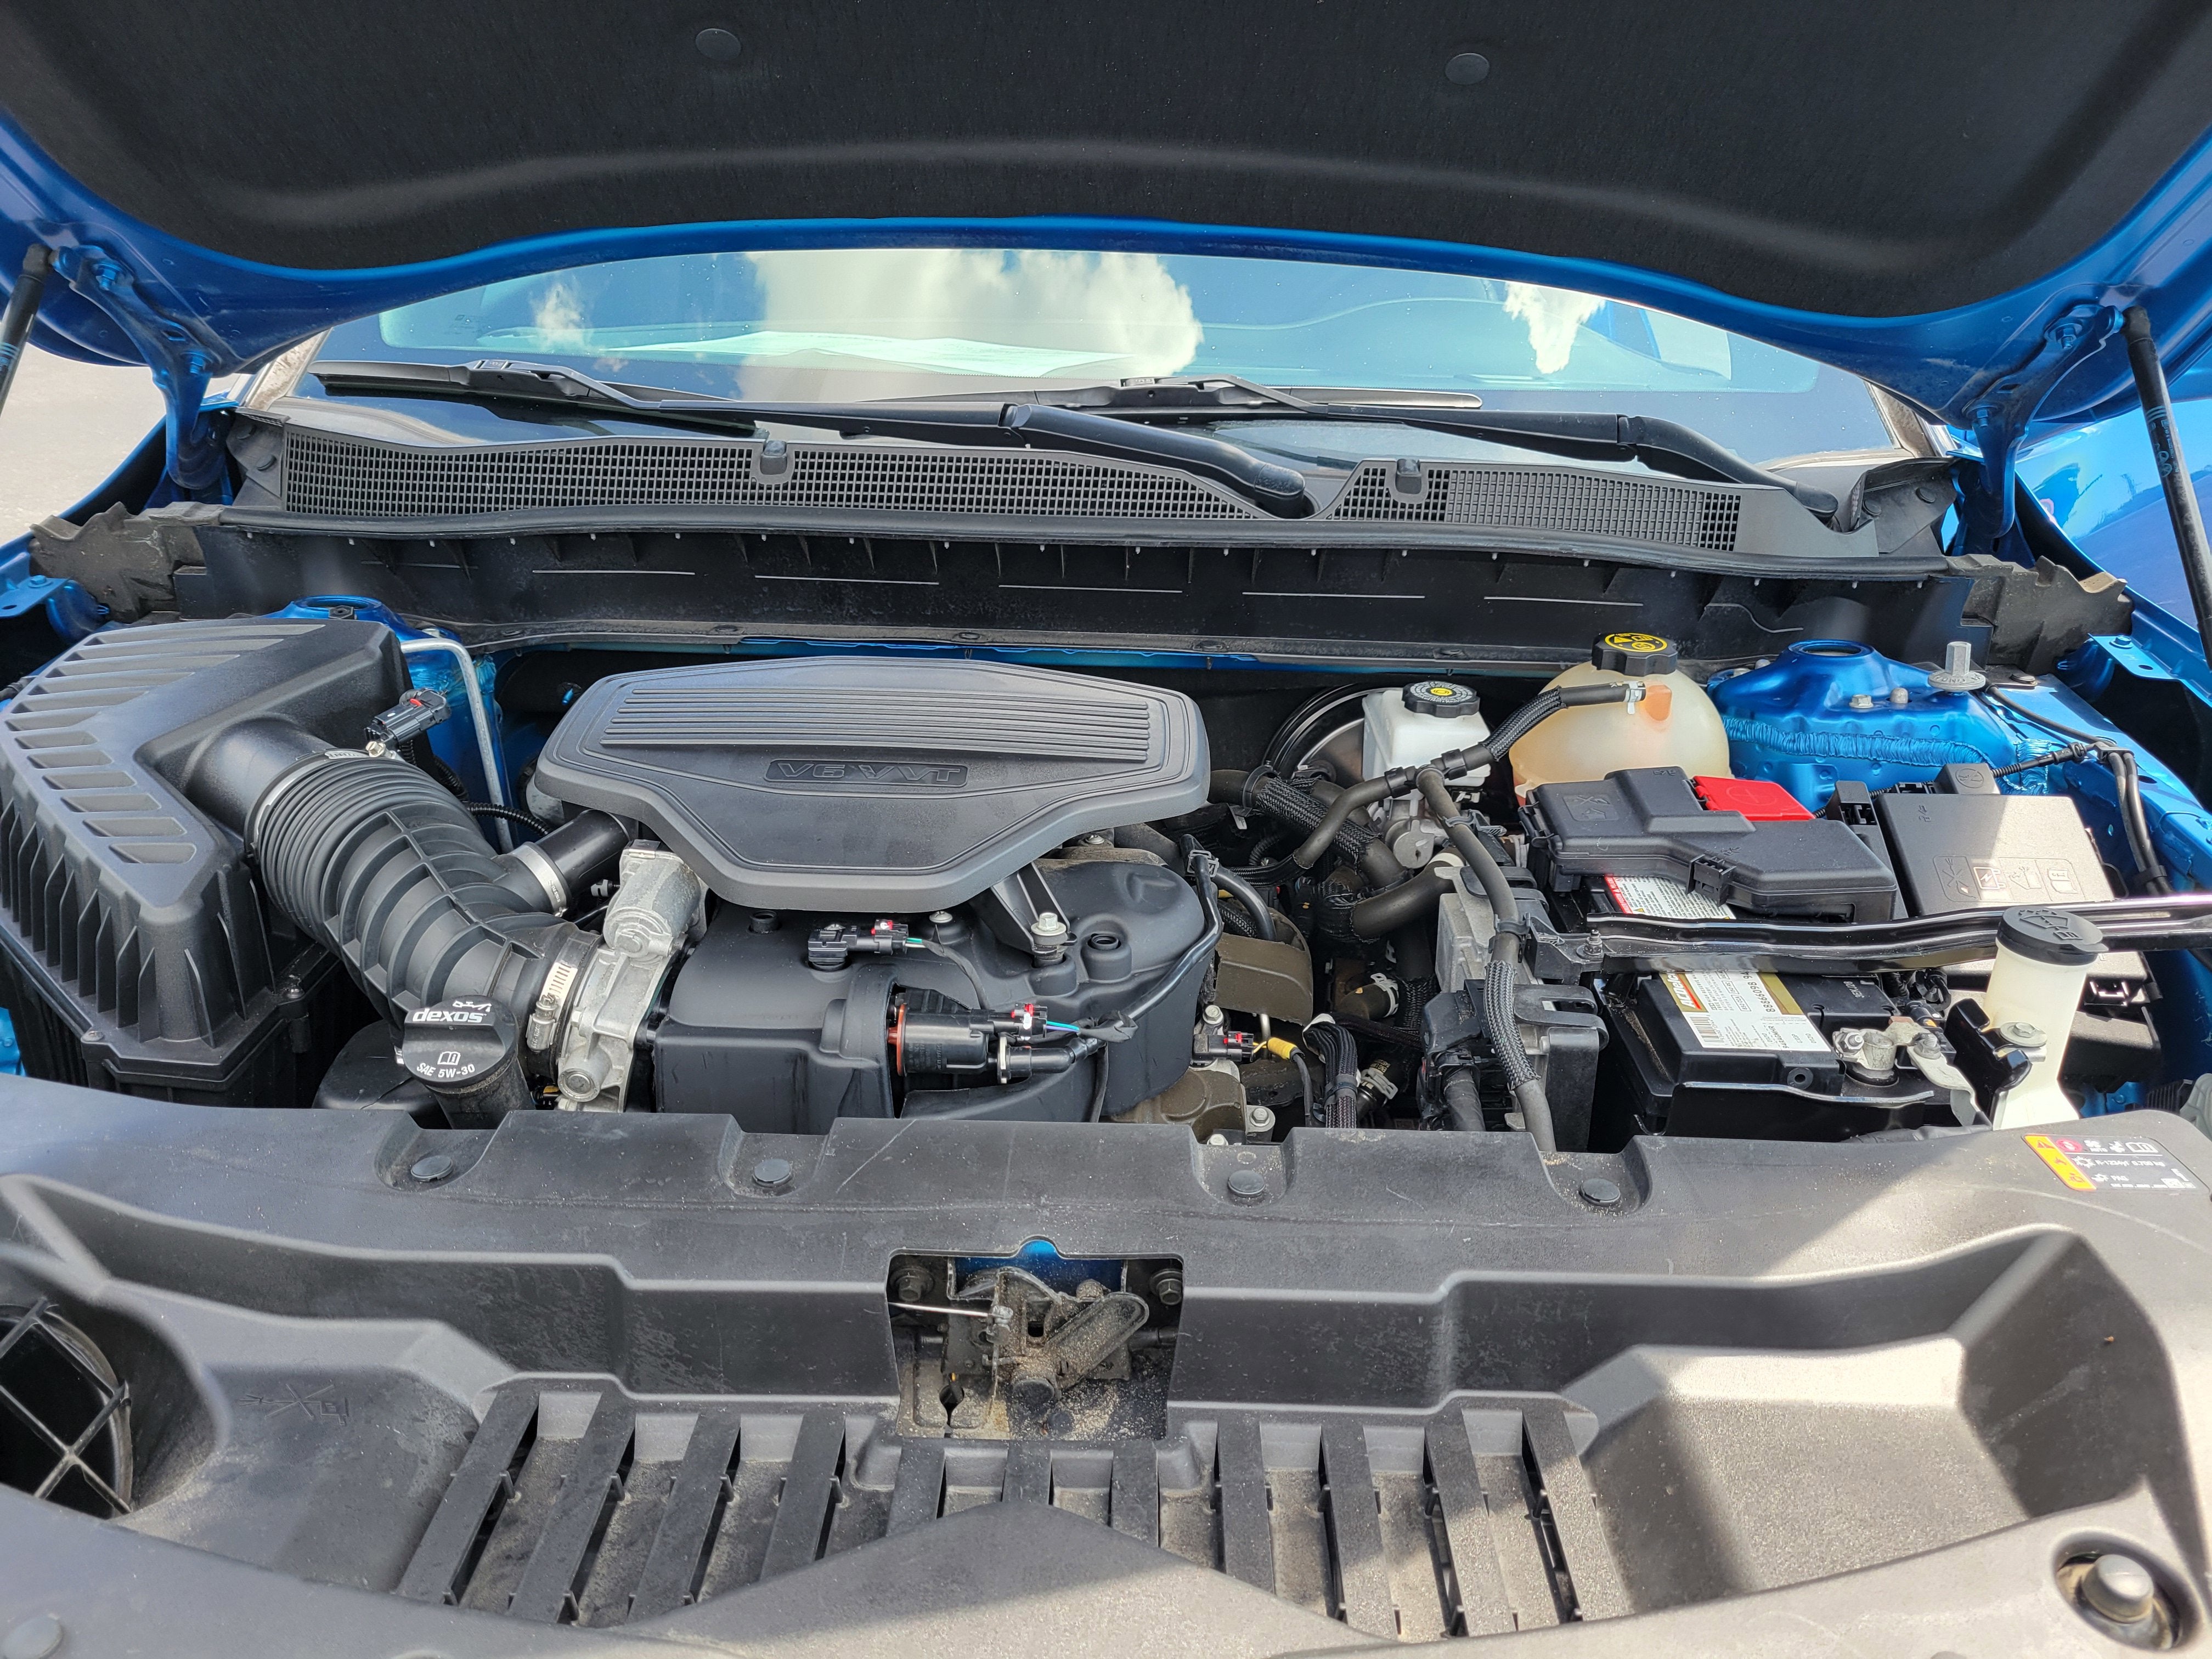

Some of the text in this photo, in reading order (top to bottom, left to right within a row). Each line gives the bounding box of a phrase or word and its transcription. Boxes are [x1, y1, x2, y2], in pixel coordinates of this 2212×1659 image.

[777, 763, 961, 782] V6 VVT
[1748, 982, 1775, 1012] 88866098
[413, 1008, 483, 1023] dexos
[417, 1063, 475, 1078] SAE 5W-30
